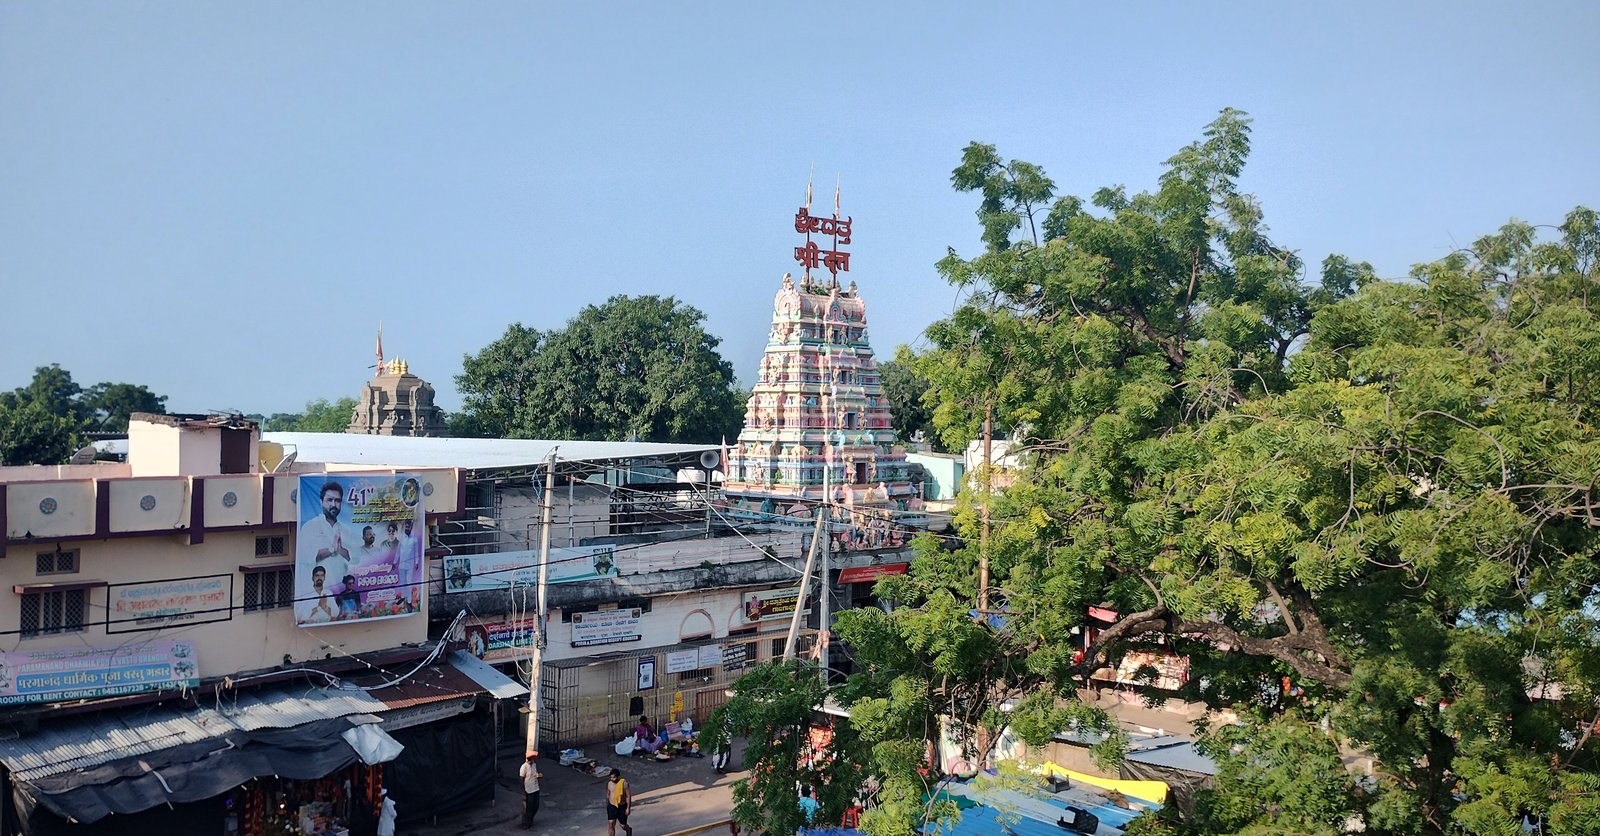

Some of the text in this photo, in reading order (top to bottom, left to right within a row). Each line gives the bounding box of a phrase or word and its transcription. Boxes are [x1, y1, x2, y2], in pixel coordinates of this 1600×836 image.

[26, 694, 42, 702] FOR
[43, 692, 62, 701] RENT
[63, 689, 96, 699] CONTACT
